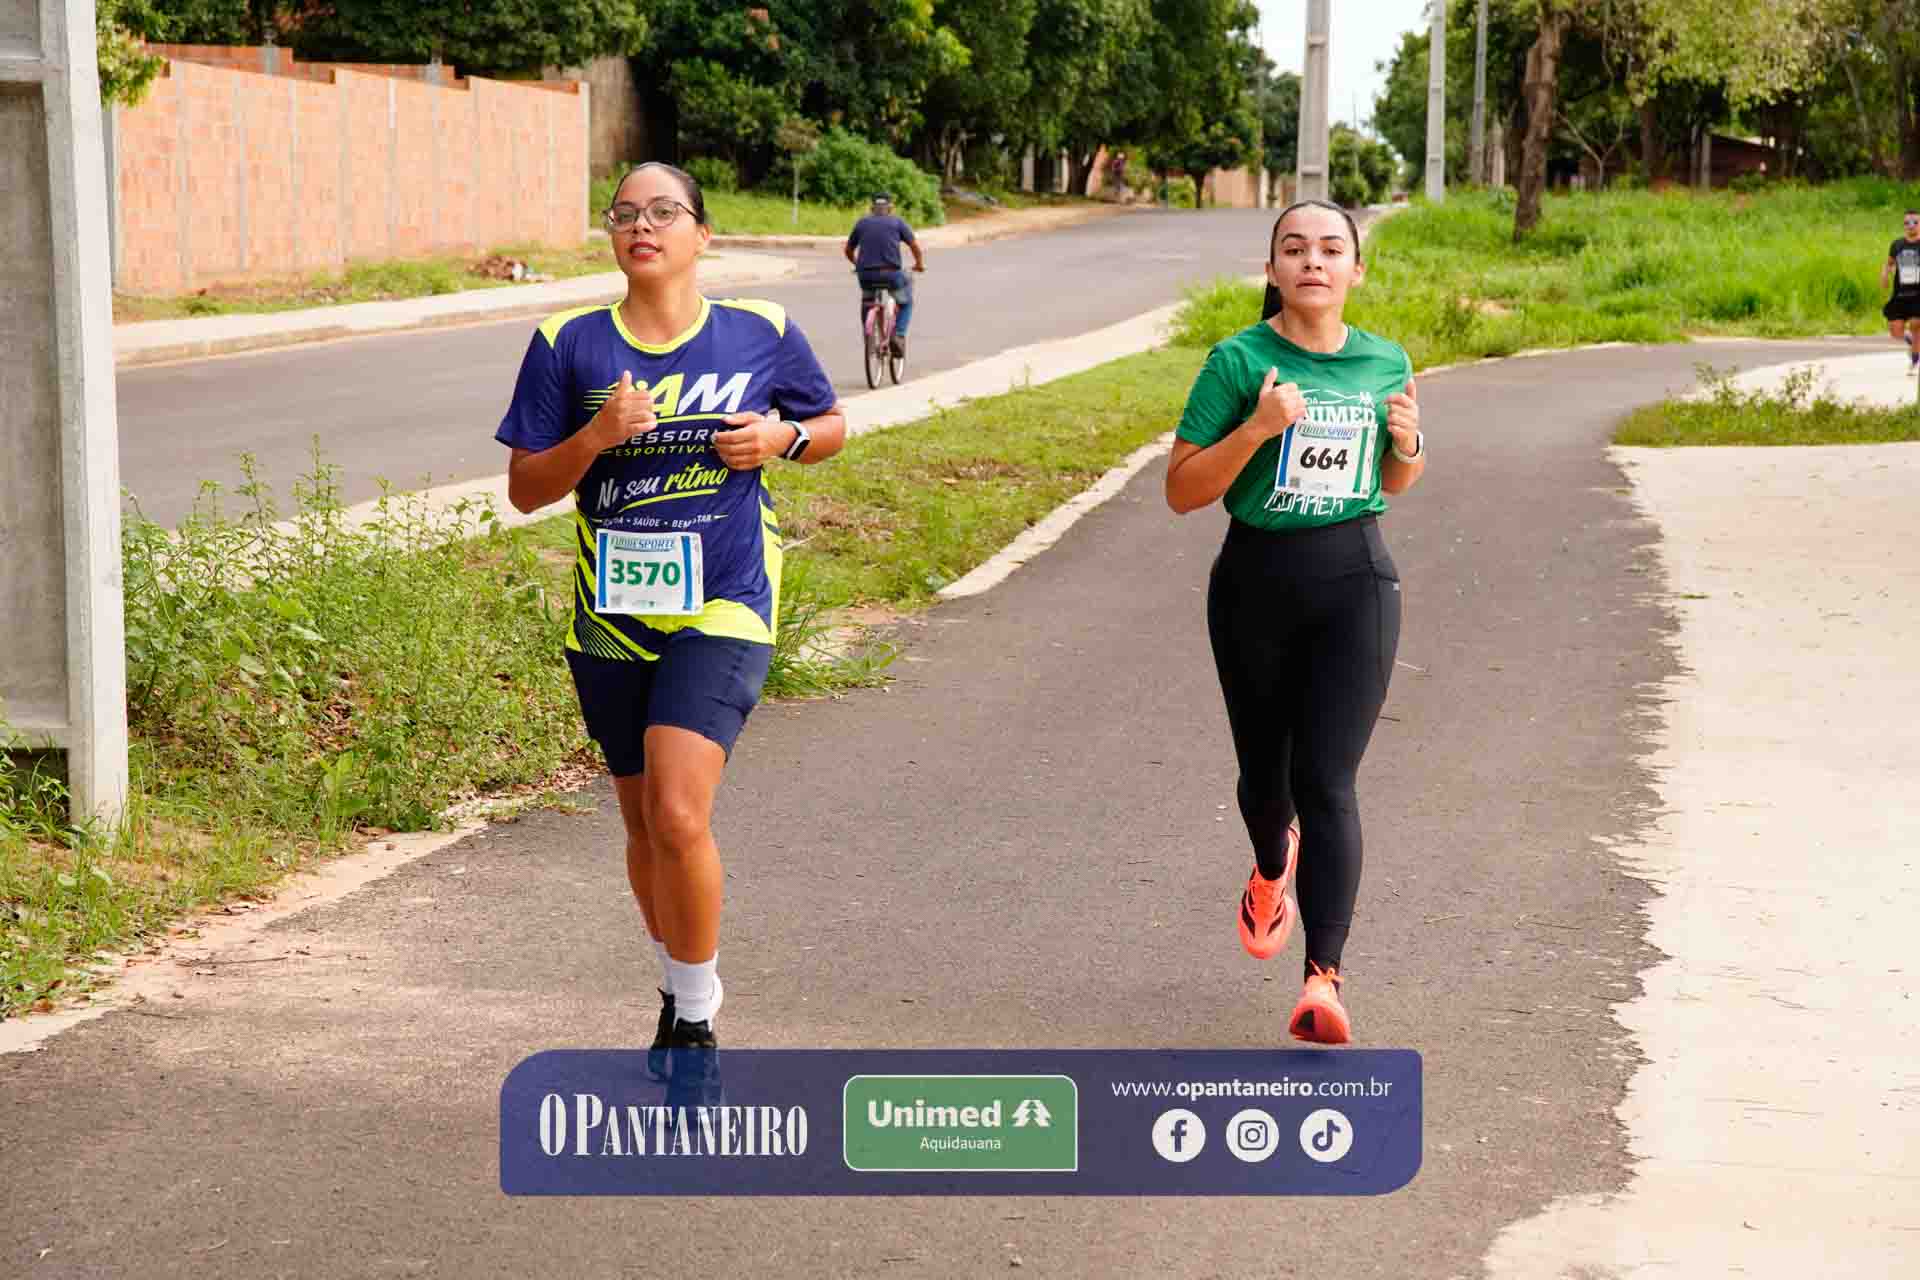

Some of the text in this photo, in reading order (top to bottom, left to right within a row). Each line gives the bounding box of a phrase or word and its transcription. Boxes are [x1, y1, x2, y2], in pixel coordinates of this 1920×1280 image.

[615, 445, 705, 457] ESPORTIVA
[1300, 446, 1348, 470] 664
[623, 475, 661, 500] seu
[663, 462, 728, 492] ritmo
[609, 559, 680, 587] 3570
